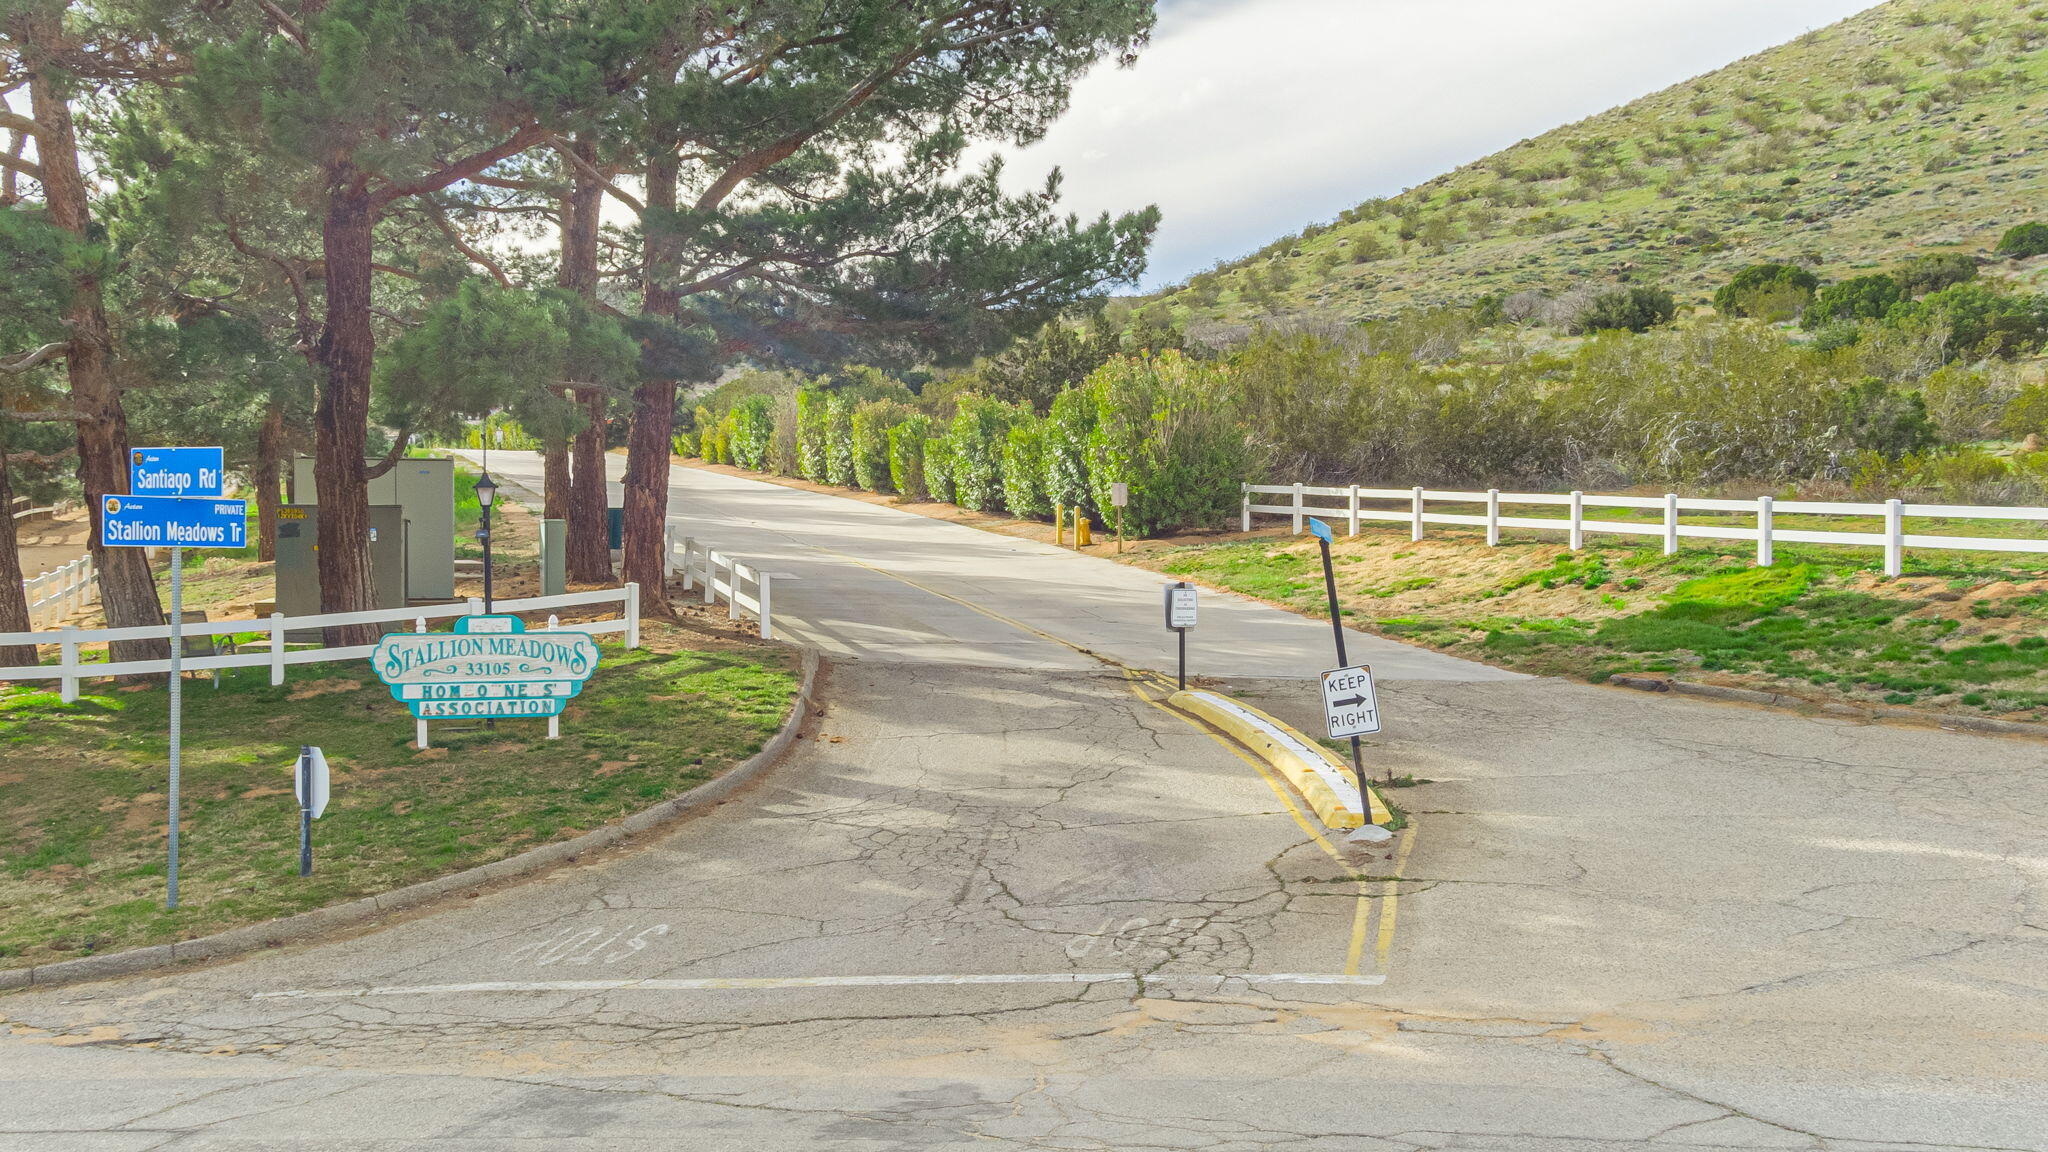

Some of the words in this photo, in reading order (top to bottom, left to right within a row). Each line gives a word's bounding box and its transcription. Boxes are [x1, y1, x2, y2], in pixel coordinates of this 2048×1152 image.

[137, 468, 192, 495] Santiago
[199, 467, 216, 489] Rd
[214, 503, 244, 516] PRIVATE
[107, 519, 161, 541] Stallion
[166, 521, 224, 542] Meadows
[230, 522, 242, 543] Tr
[385, 638, 484, 679] STALLION
[488, 637, 588, 675] MEADOWS
[465, 662, 511, 676] 33105
[1328, 675, 1365, 692] KEEP
[422, 700, 553, 716] ASSOCIATION
[1331, 709, 1374, 728] RIGHT
